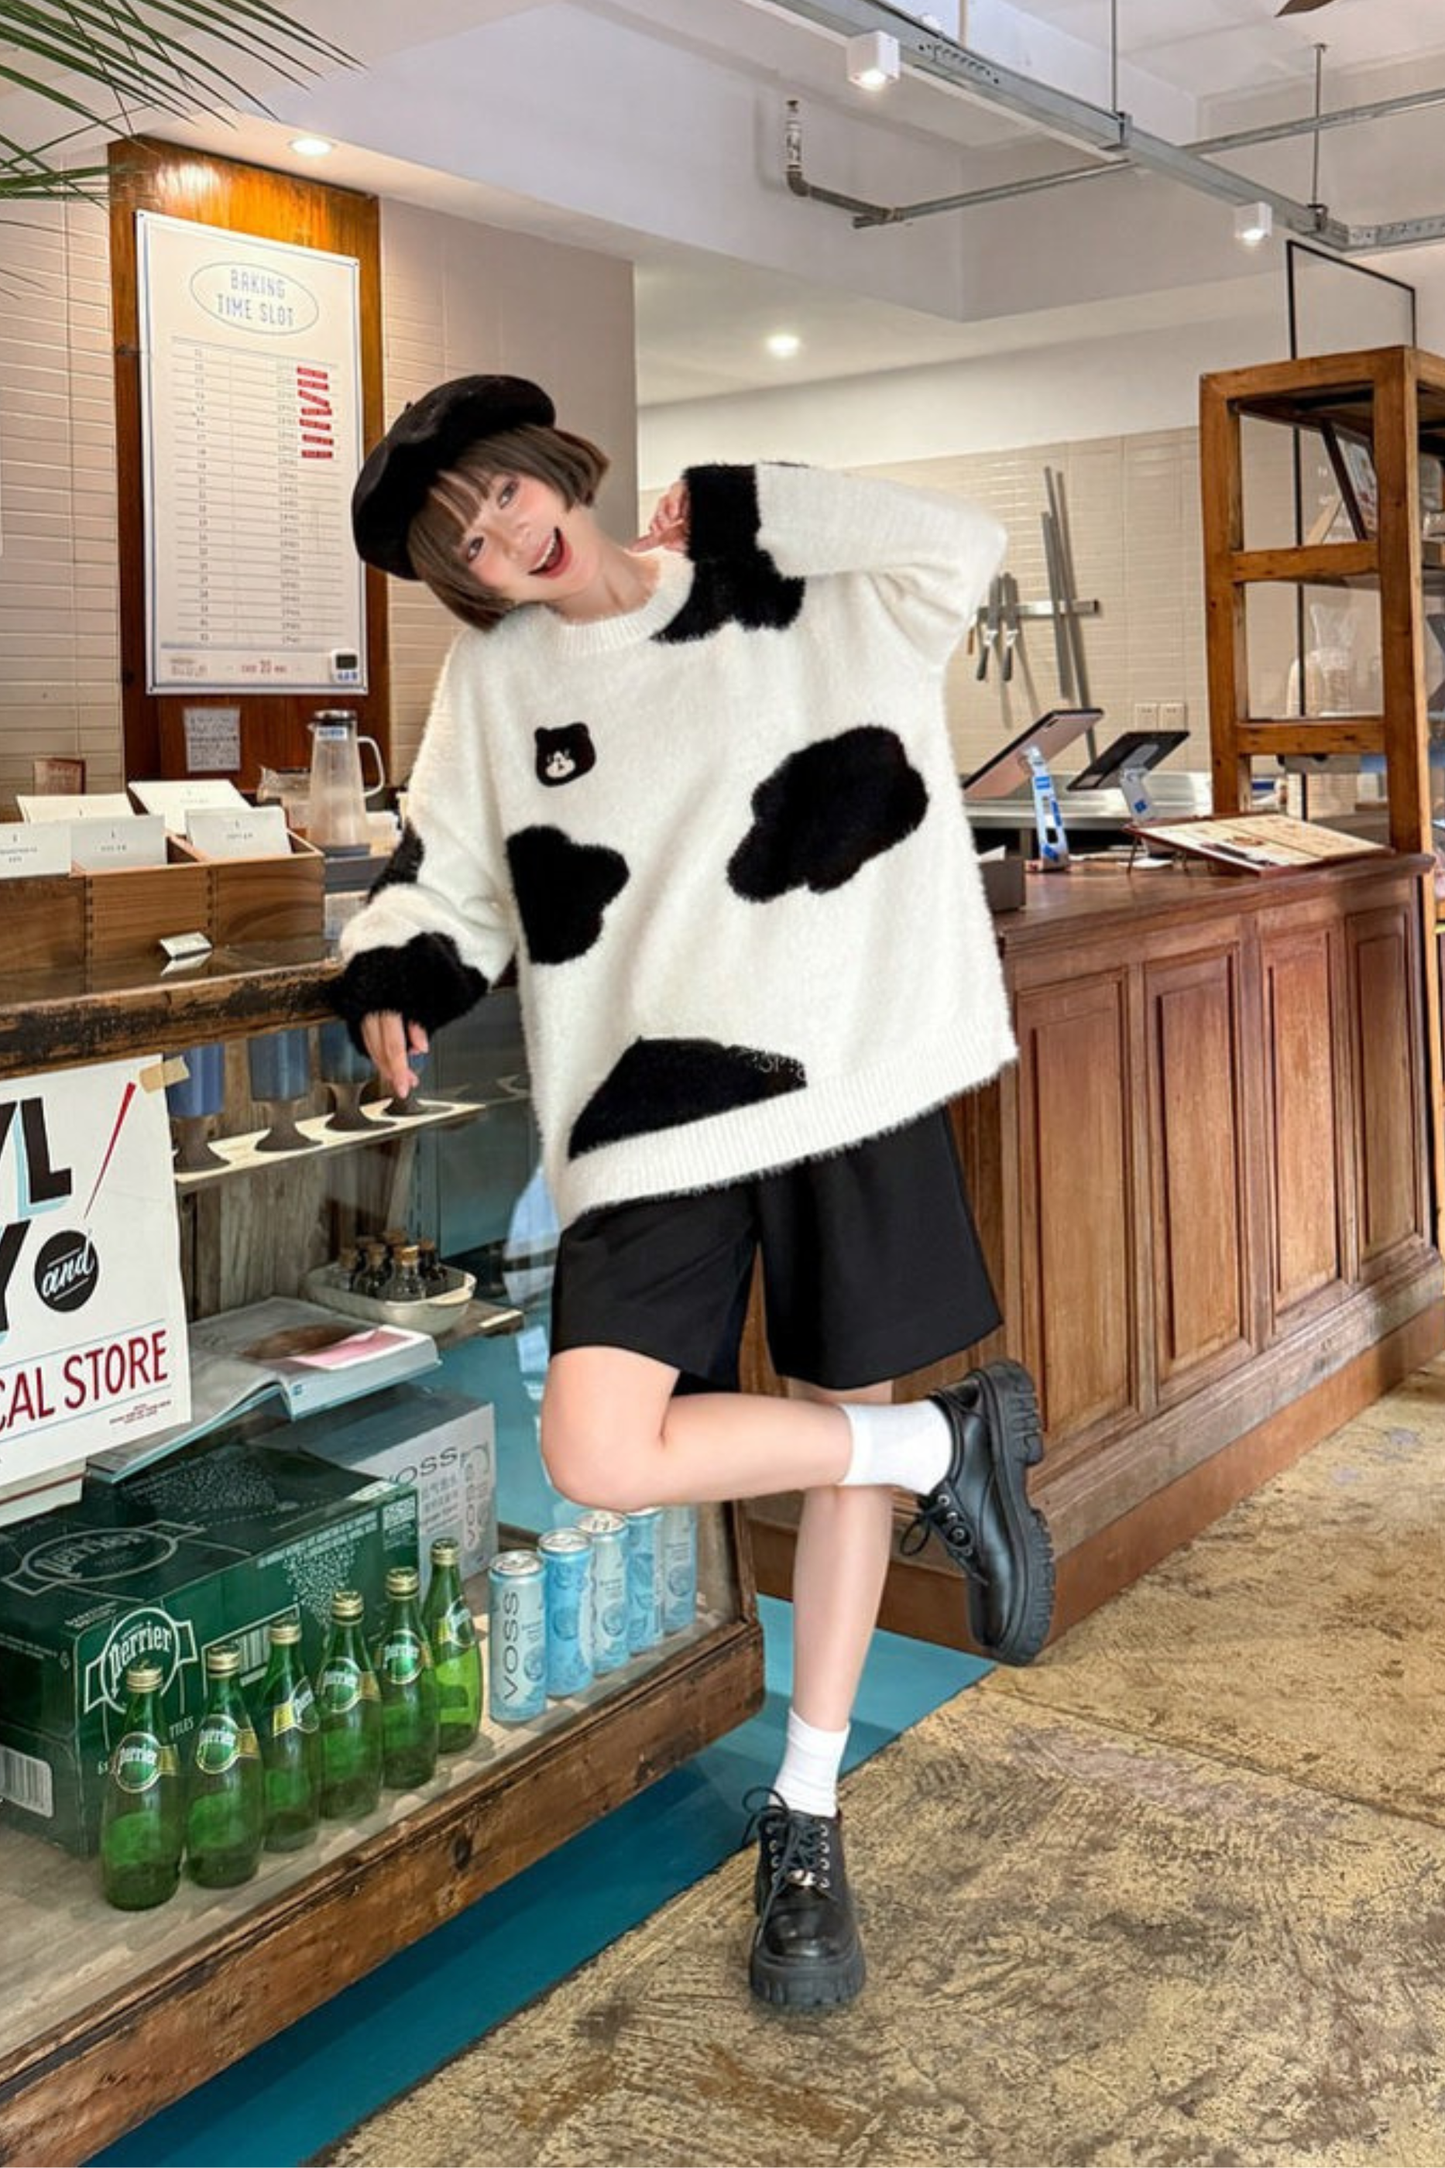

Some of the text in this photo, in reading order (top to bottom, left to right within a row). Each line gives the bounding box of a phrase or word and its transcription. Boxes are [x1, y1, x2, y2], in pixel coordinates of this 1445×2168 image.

[217, 293, 293, 327] TIME SLOT
[231, 269, 286, 299] BAKING
[0, 1096, 72, 1204] L
[42, 1238, 95, 1298] and
[63, 1330, 168, 1410] STORE
[388, 1446, 457, 1484] OSS
[503, 1591, 519, 1700] VOSS
